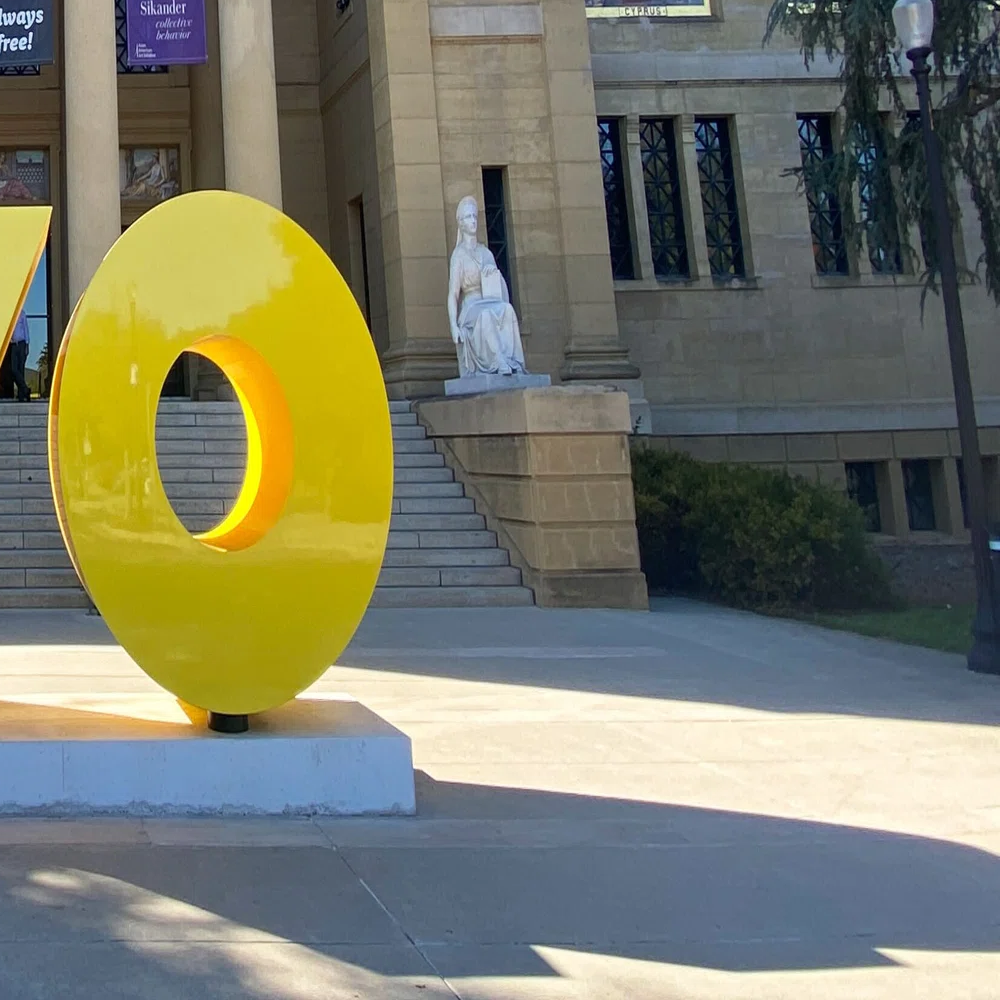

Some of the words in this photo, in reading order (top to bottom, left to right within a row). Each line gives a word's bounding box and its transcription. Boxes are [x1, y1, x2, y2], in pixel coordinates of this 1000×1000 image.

[140, 0, 187, 16] Sikander
[624, 6, 662, 16] CYPRUS
[155, 18, 193, 29] collective
[156, 29, 192, 40] behavior
